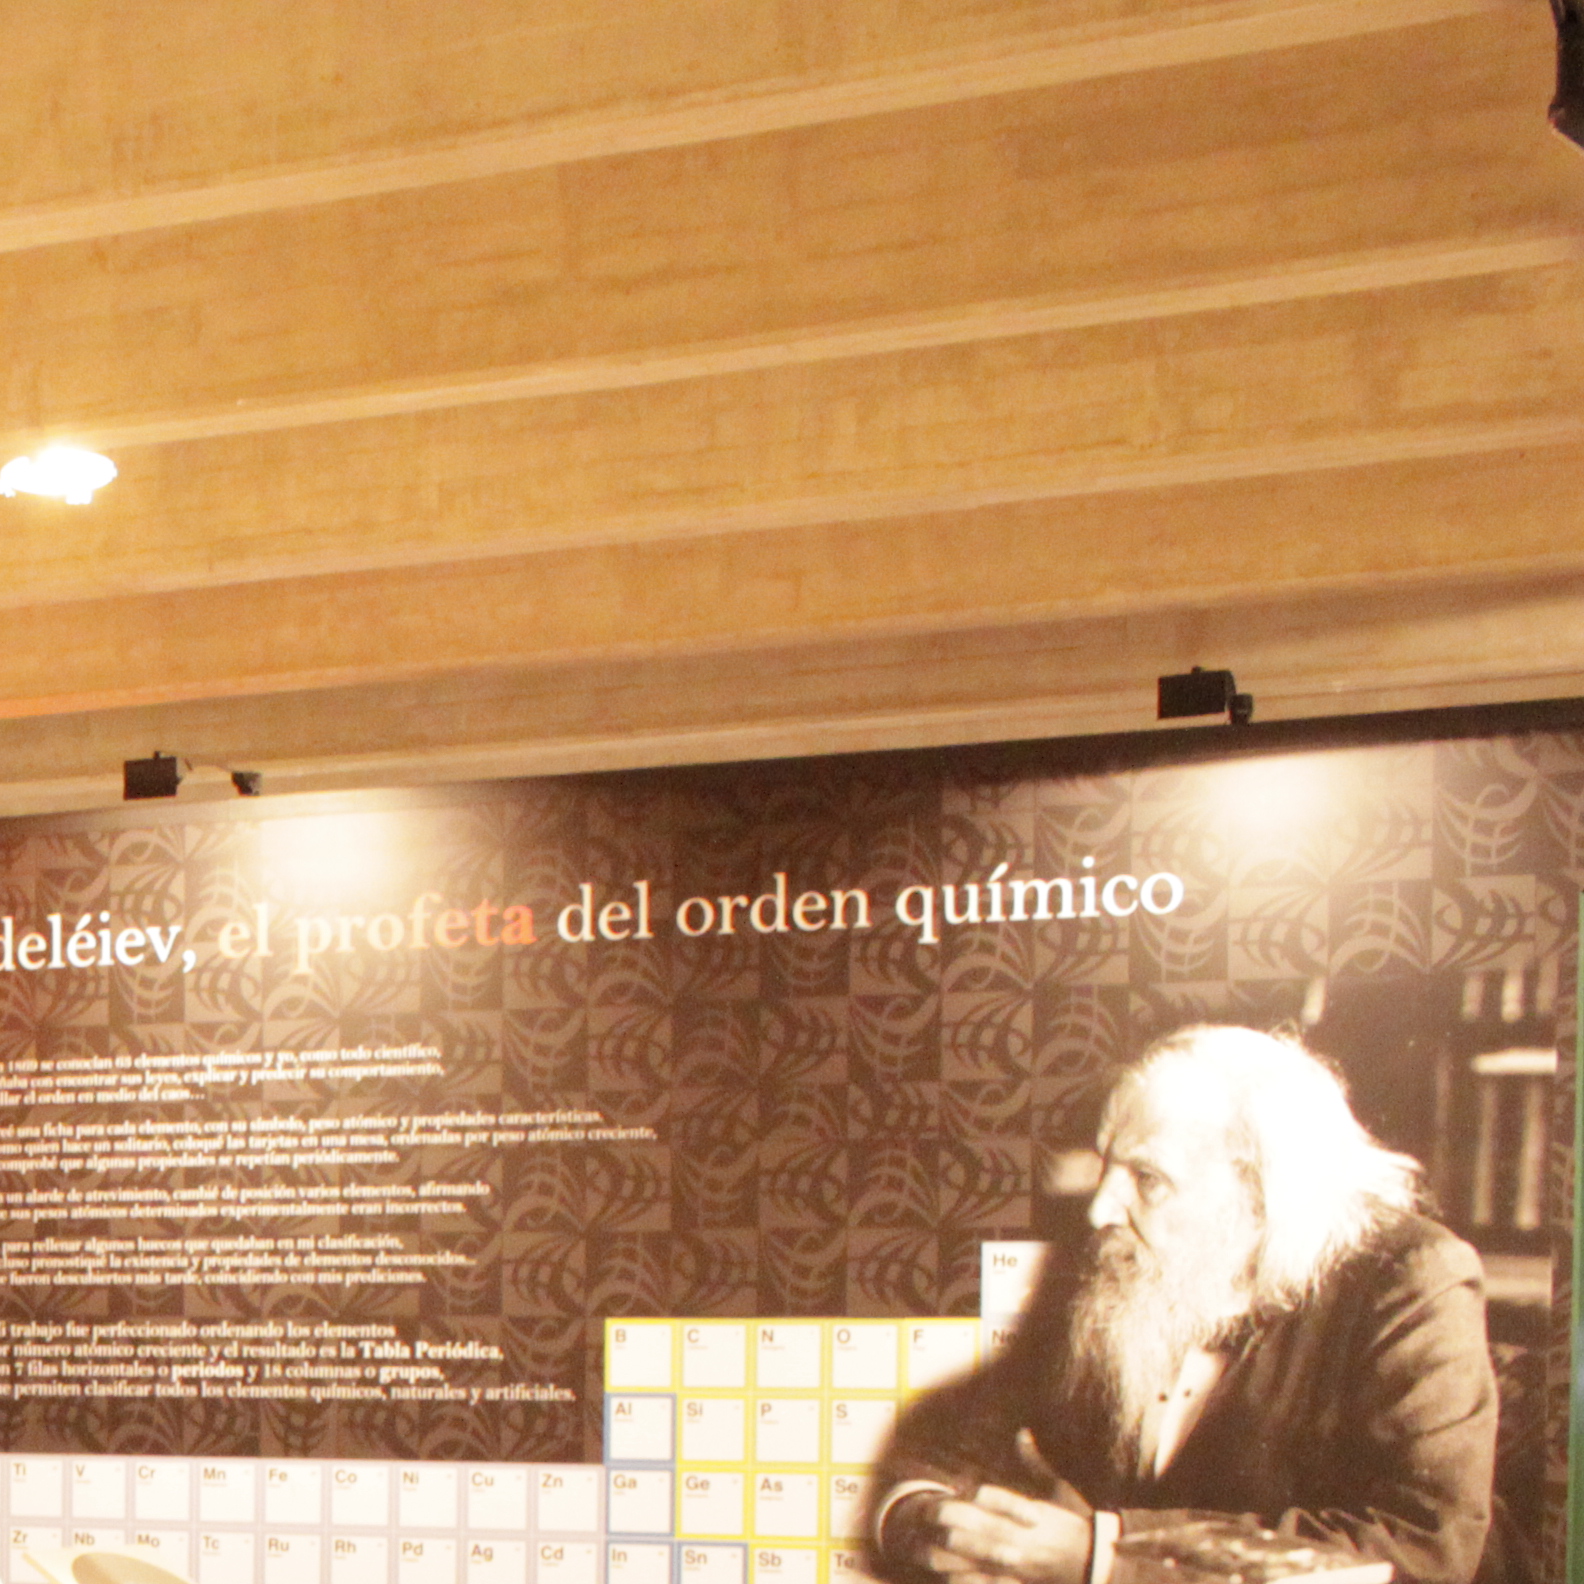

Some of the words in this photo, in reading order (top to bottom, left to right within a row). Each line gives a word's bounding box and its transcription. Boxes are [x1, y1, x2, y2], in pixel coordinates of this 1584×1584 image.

[218, 905, 273, 960] el
[296, 894, 536, 975] profeta
[557, 881, 653, 943] del
[675, 872, 872, 938] orden
[895, 855, 1185, 944] químico
[10, 1320, 63, 1343] trabajo
[66, 1320, 90, 1337] fue
[92, 1320, 197, 1343] perfeccionado
[199, 1320, 283, 1338] ordenando
[287, 1321, 311, 1338] los
[313, 1321, 396, 1338] elementos
[13, 1341, 71, 1358] número
[74, 1341, 134, 1358] atómico
[137, 1341, 207, 1358] creciente
[210, 1345, 220, 1362] y
[224, 1341, 238, 1358] el
[242, 1341, 316, 1359] resultado
[319, 1345, 337, 1359] es
[340, 1341, 356, 1359] la
[358, 1341, 410, 1359] Tabla
[414, 1341, 504, 1361] Periódica,
[14, 1363, 23, 1377] 7
[28, 1360, 58, 1377] filas
[62, 1360, 155, 1377] horizontales
[157, 1365, 169, 1377] o
[246, 1365, 258, 1382] y
[263, 1363, 282, 1378] 18
[285, 1361, 361, 1379] columnas
[364, 1366, 376, 1379] o
[379, 1365, 446, 1384] grupos,
[14, 1381, 81, 1400] permiten
[84, 1380, 153, 1397] clasificar
[156, 1381, 198, 1398] todos
[201, 1381, 223, 1398] los
[227, 1381, 307, 1399] elementos
[311, 1382, 387, 1402] químicos,
[390, 1383, 466, 1400] naturales
[469, 1387, 481, 1406] y
[485, 1383, 577, 1401] artificiales,
[614, 1474, 637, 1489] Ga
[685, 1550, 707, 1564] Sn
[759, 1552, 782, 1567] Sb
